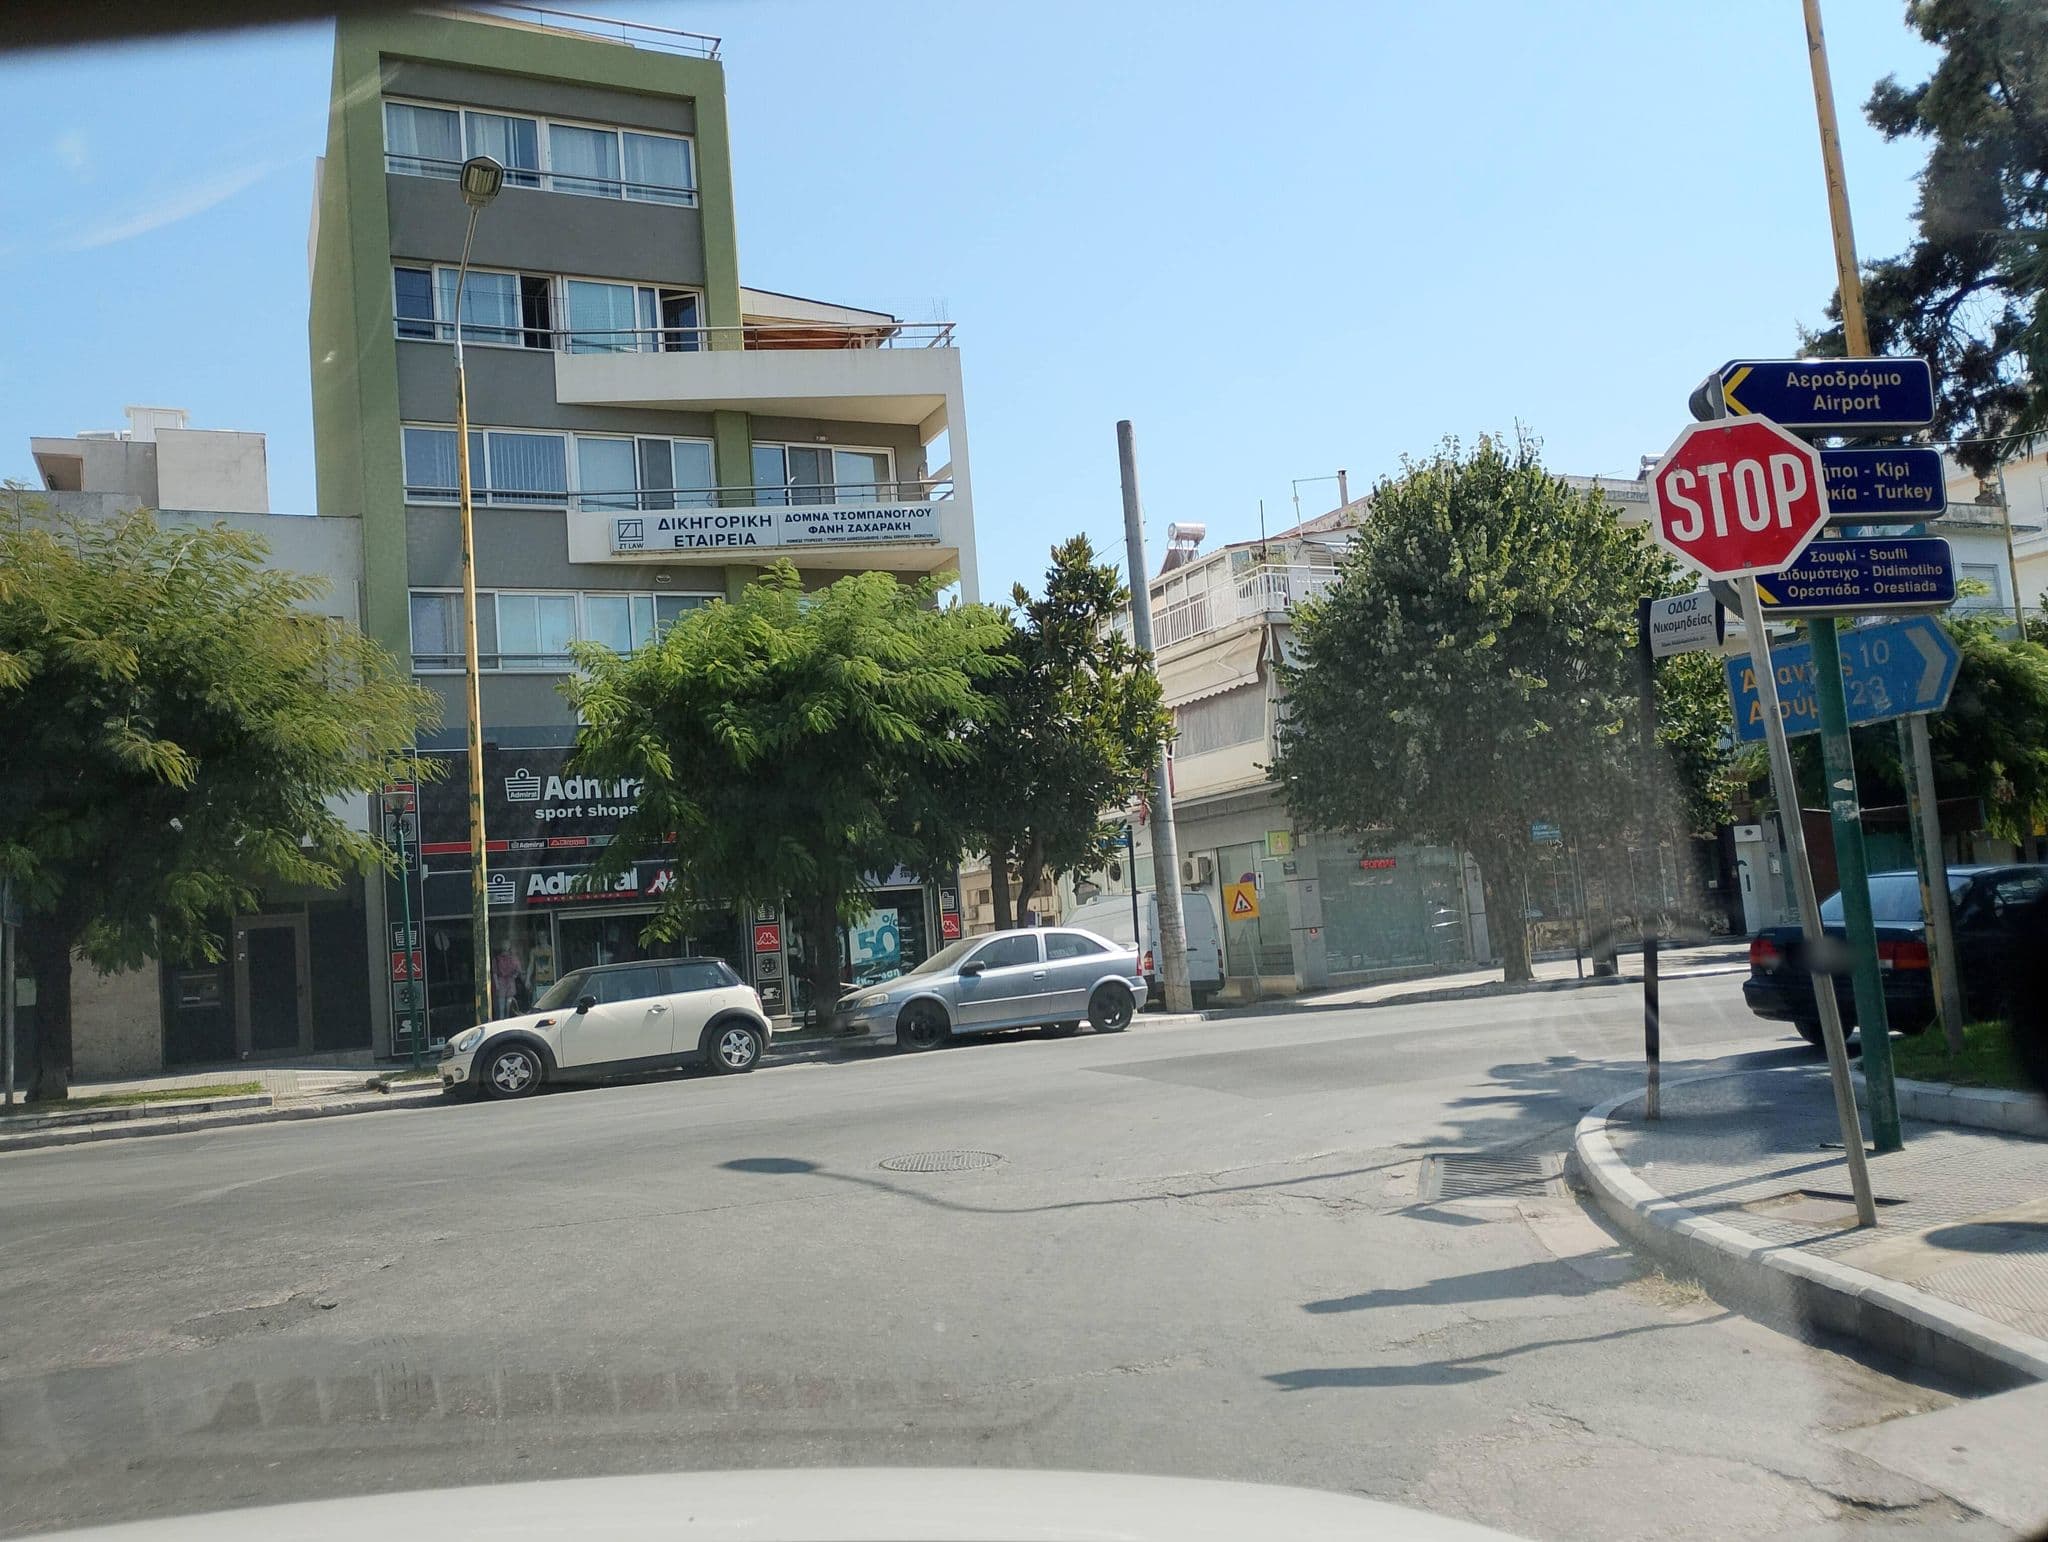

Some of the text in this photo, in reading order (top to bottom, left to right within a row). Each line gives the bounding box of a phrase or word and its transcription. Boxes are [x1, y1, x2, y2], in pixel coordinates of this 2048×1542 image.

[1786, 370, 1902, 390] Αεροδρόμιο
[1813, 394, 1881, 414] Airport
[1822, 463, 1859, 482] ήποι
[1875, 462, 1910, 480] Kipi
[1665, 453, 1807, 542] STOP
[1874, 483, 1933, 502] Turkey
[658, 514, 772, 531] ΔΙΚΗΓΟΡΙΚΗ
[784, 508, 932, 523] ΔΟΜΝΑ ΤΣΟΜΠΑΝΟΓΛΟΥ
[808, 521, 911, 534] ΦΑΝΗ ΖΑΧΑΡΑΚΗ
[628, 542, 645, 550] LAW
[674, 532, 757, 548] ΕΤΑΙΡΕΙΑ
[1810, 550, 1857, 564] Σουφλί
[1869, 548, 1909, 561] Soufli
[1777, 567, 1860, 583] Διδυμότειχο
[1872, 564, 1943, 577] Didimotiho
[1788, 582, 1861, 599] Ορεστιάδα
[1873, 580, 1938, 594] Orestiada
[1667, 598, 1698, 615] ΟΔΟΣ
[1653, 613, 1713, 634] Νικομηδείας
[1861, 639, 1890, 668] 10
[1851, 675, 1888, 705] 23
[510, 790, 538, 799] Admiral
[535, 804, 639, 822] sport shops
[519, 840, 545, 849] Admiral
[857, 925, 899, 959] 50
